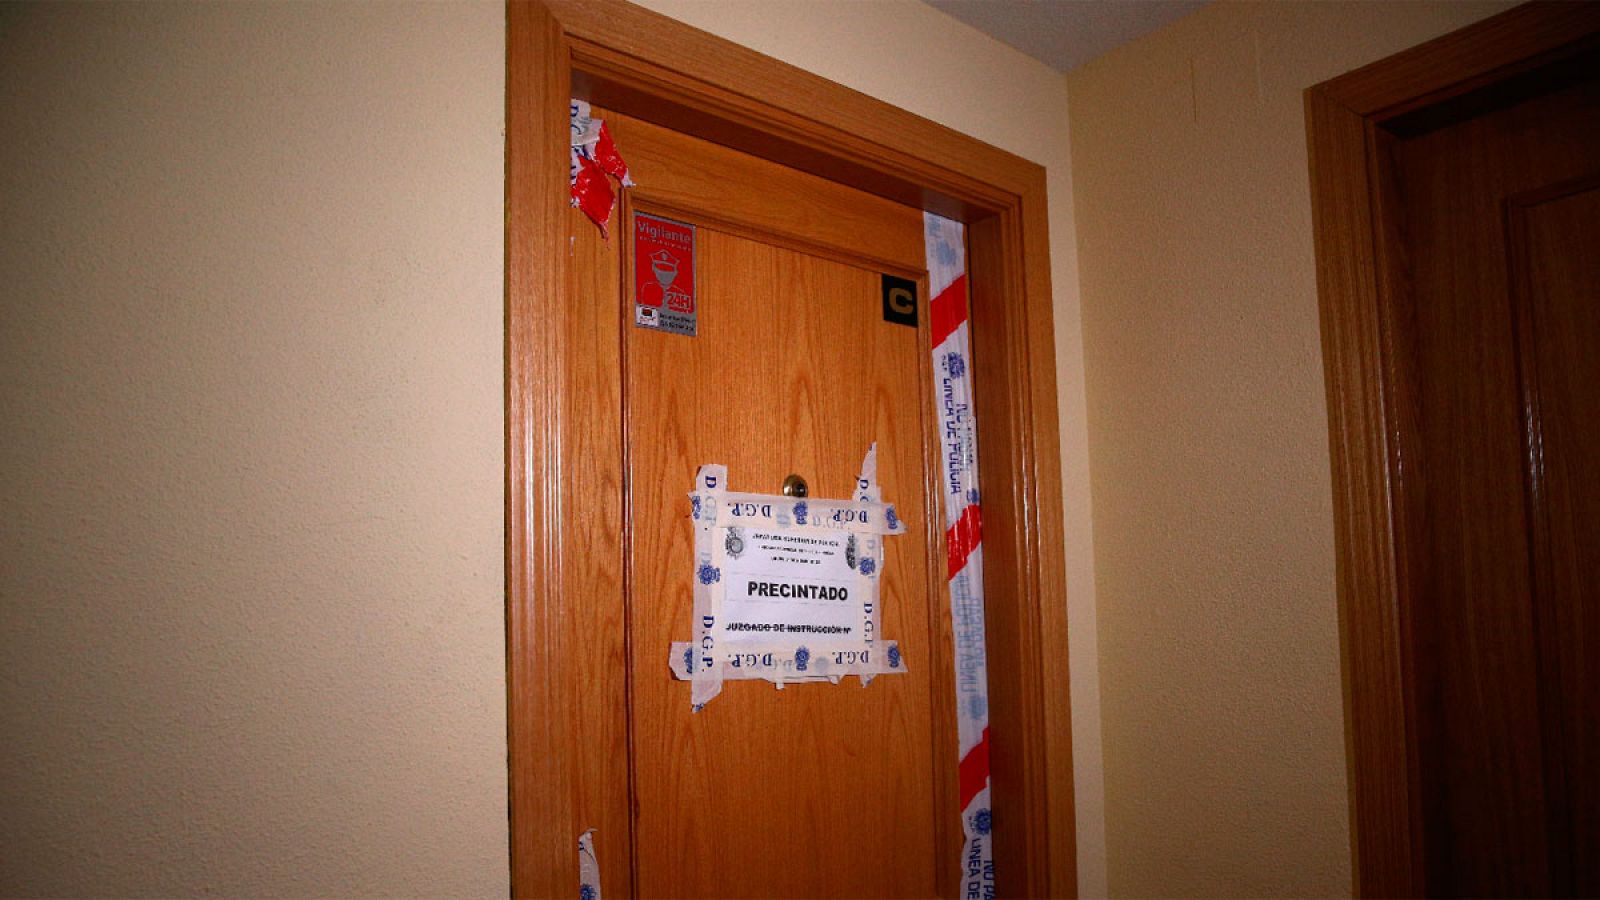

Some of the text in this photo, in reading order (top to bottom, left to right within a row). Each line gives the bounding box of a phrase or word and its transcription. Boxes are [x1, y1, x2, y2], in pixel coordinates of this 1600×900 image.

[637, 221, 691, 243] Vigilante
[667, 292, 690, 309] 24H
[888, 287, 914, 315] C
[728, 502, 772, 518] D.G.P.
[830, 508, 868, 523] D.G.P.
[747, 581, 848, 601] PRECINTADO
[726, 622, 771, 632] JUZGADO
[773, 623, 785, 632] DE
[702, 615, 715, 672] D.G.P.
[728, 653, 773, 668] D.G.P.
[831, 651, 869, 665] D.G.P.
